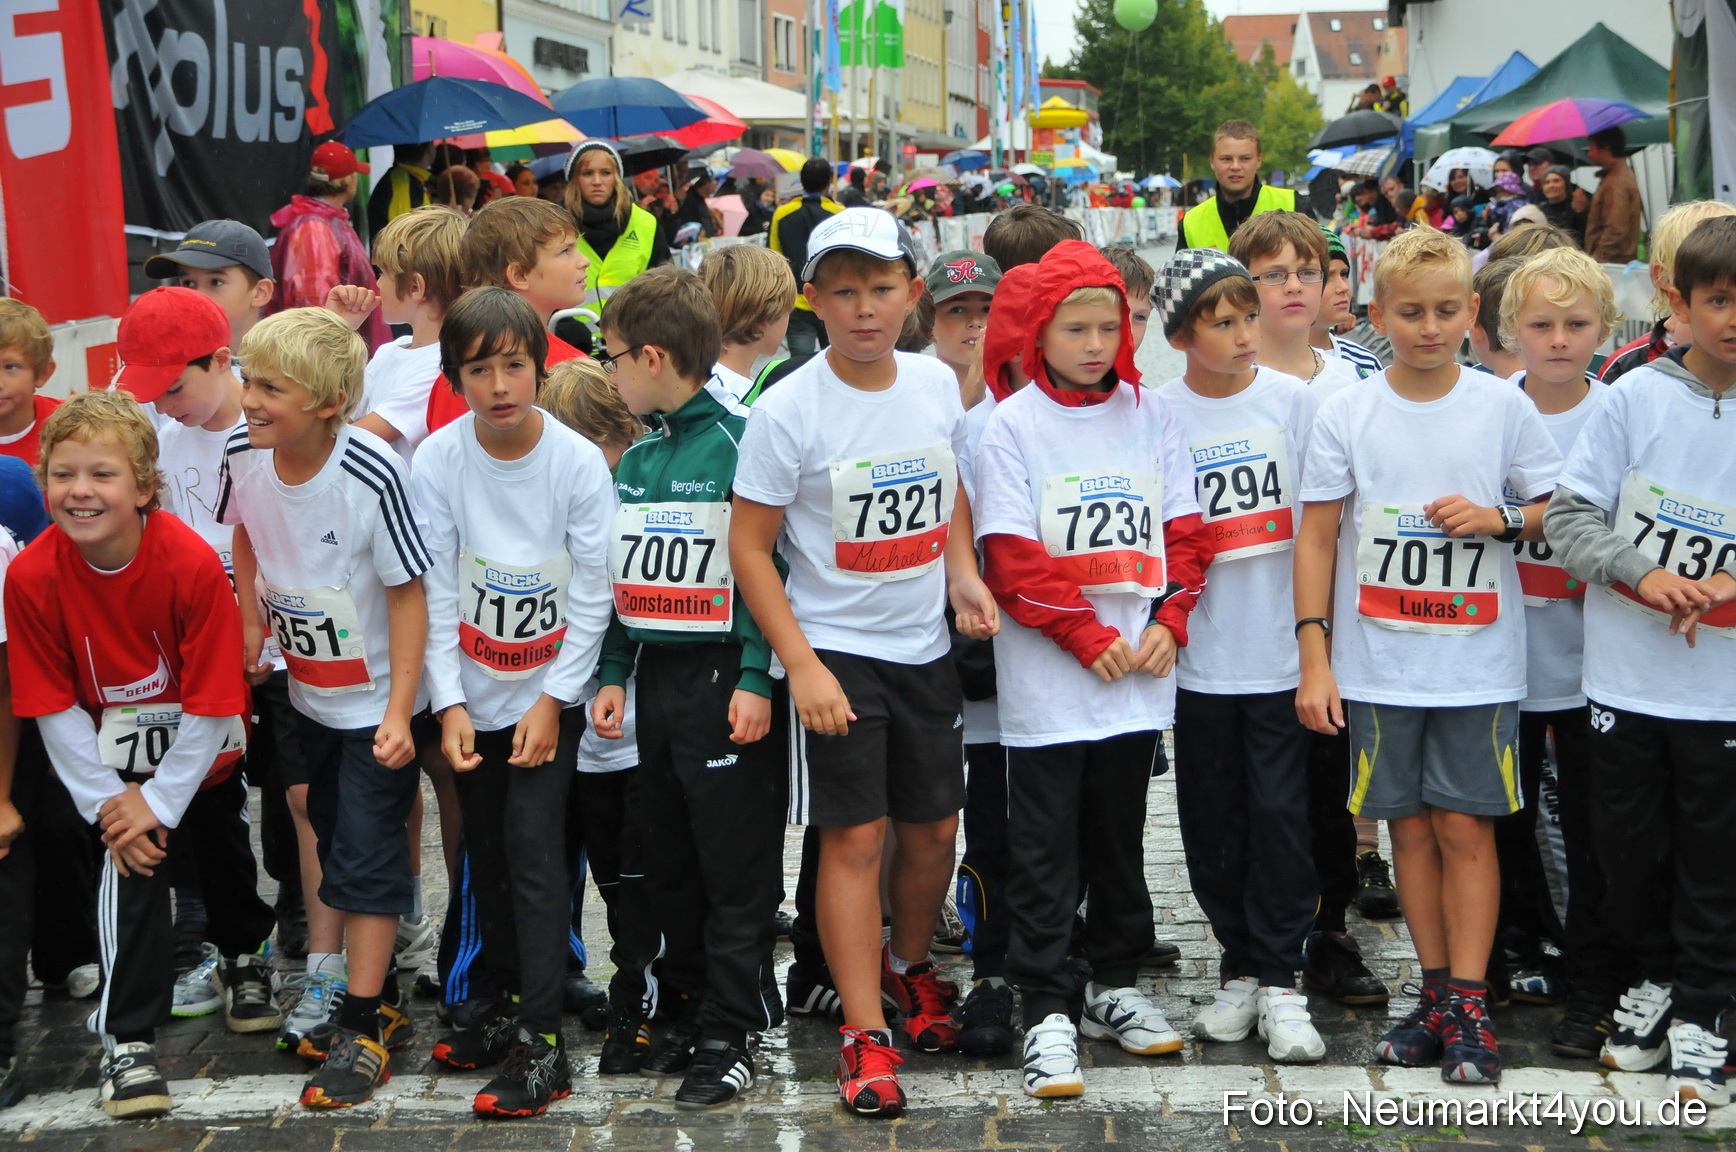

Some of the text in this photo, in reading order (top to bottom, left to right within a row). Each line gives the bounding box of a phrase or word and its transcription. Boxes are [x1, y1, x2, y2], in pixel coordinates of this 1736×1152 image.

[1194, 439, 1251, 464] BOCK
[872, 457, 926, 479] BOCK
[618, 483, 642, 497] JAKO
[672, 479, 716, 495] Bergler C.
[1080, 475, 1131, 492] BOCK
[1195, 461, 1282, 518] 294
[646, 511, 694, 526] BOCK
[849, 478, 942, 538] 7321
[1659, 497, 1725, 527] BOCK
[1057, 500, 1152, 551] 7234
[1215, 524, 1264, 541] Bastian
[320, 537, 339, 546] adidas
[620, 534, 717, 583] 7007
[847, 541, 928, 573] Michael
[1089, 555, 1134, 577] André
[1373, 537, 1485, 588] 7017
[485, 567, 541, 588] BOCK
[721, 577, 729, 586] M
[1362, 573, 1368, 582] 6
[1488, 581, 1495, 590] M
[471, 581, 559, 639] 7125
[622, 590, 711, 615] Constantin
[1400, 596, 1458, 619] Lukas
[474, 637, 552, 667] Cornelius
[126, 678, 160, 698] DEHN
[706, 758, 732, 768] JAKO
